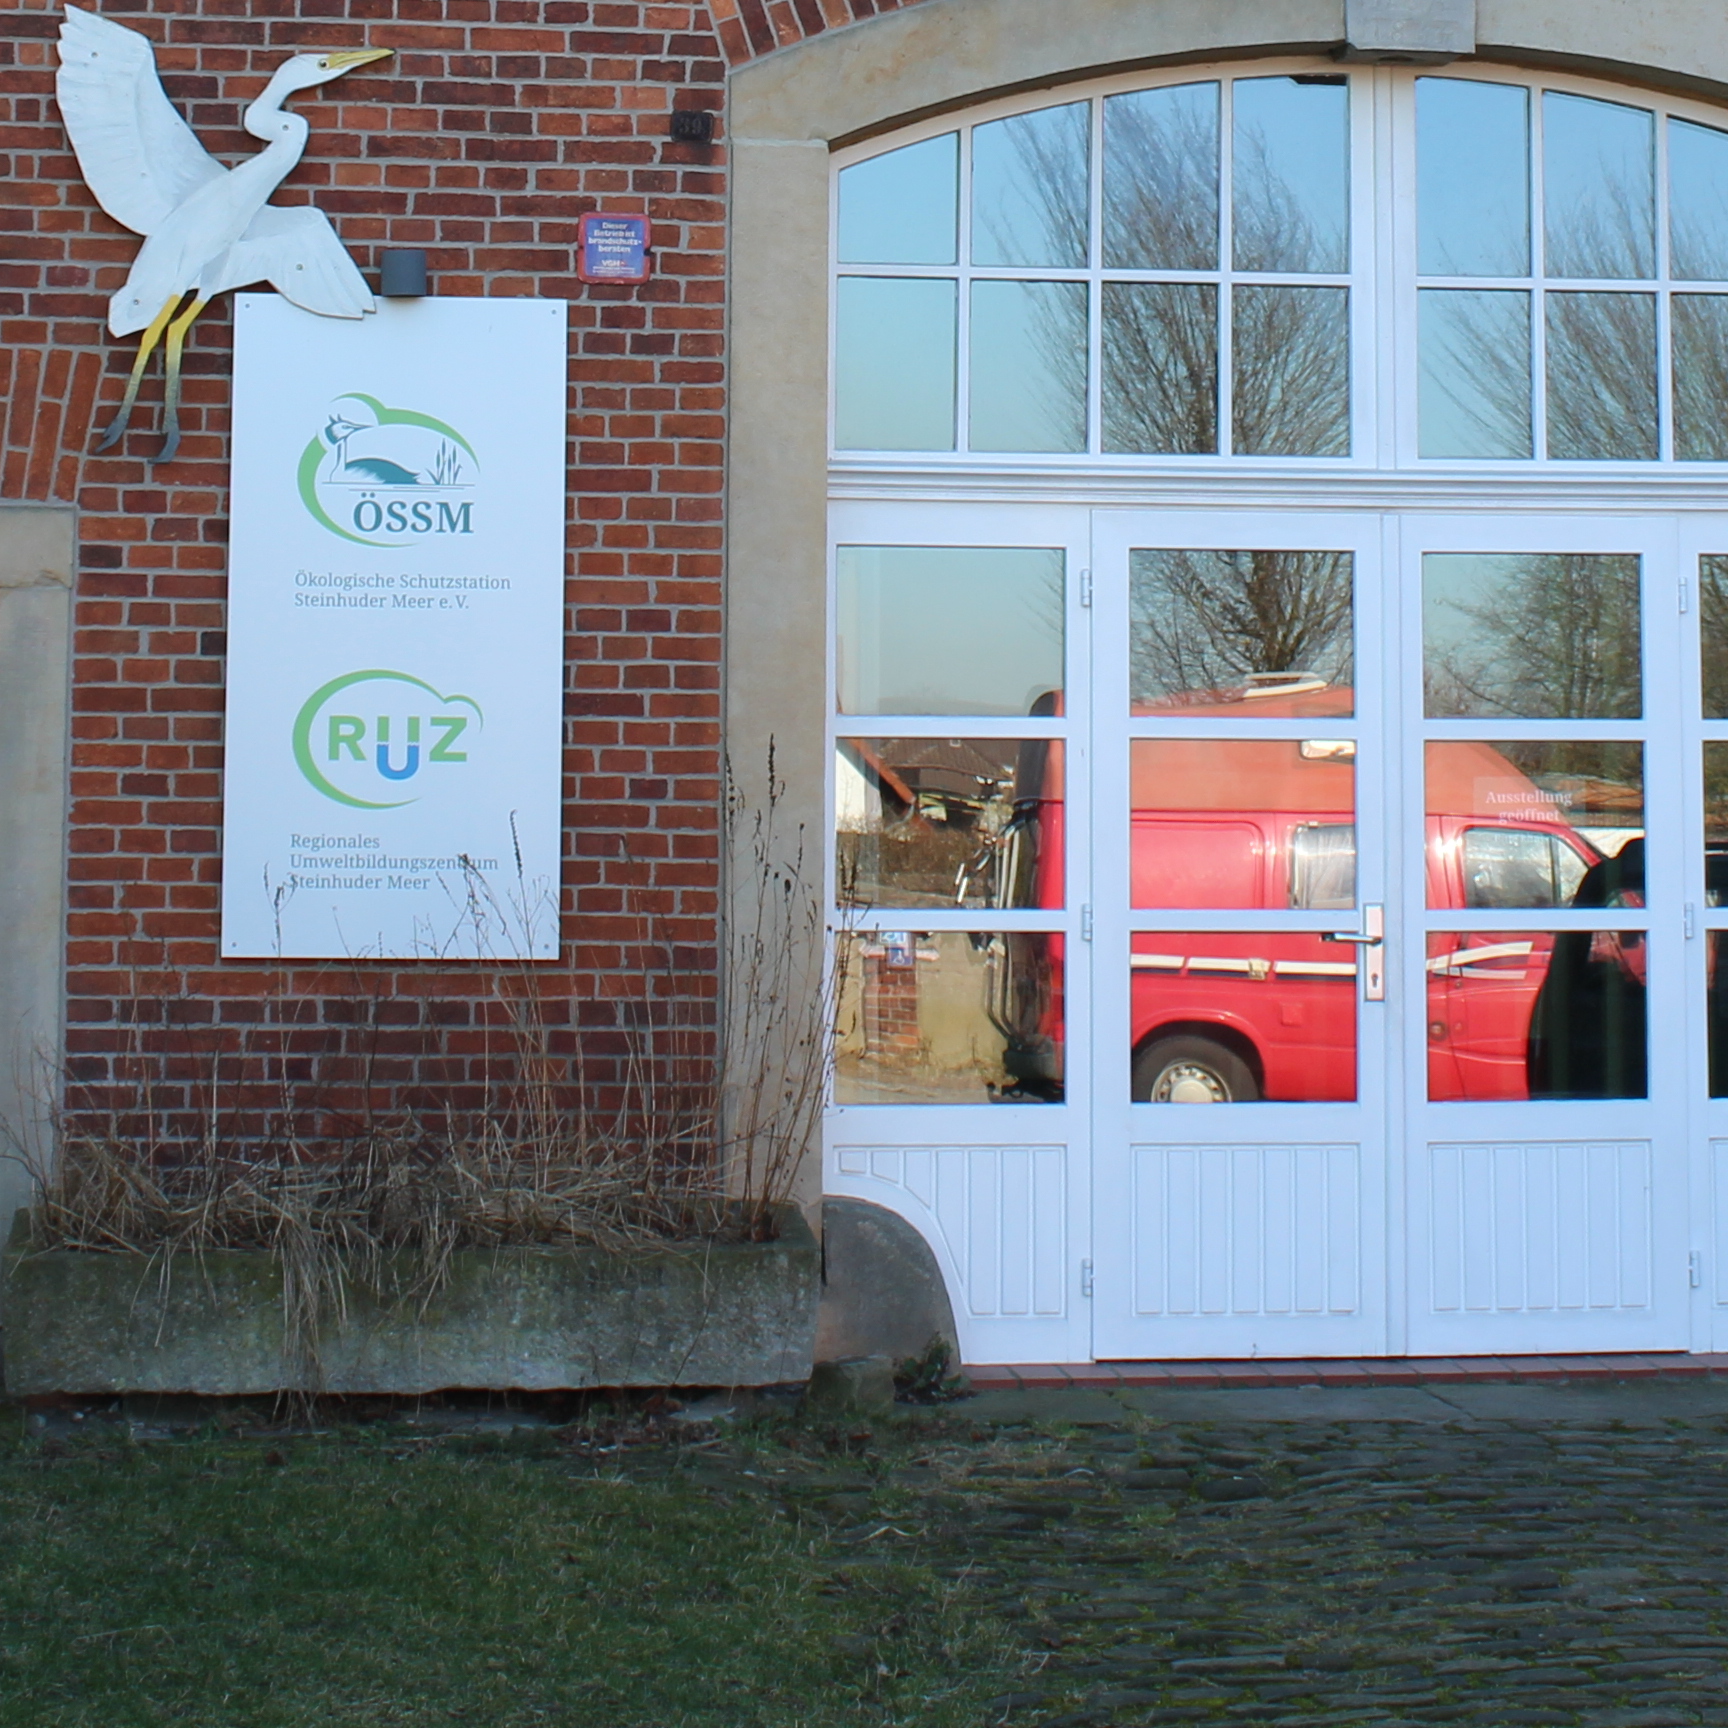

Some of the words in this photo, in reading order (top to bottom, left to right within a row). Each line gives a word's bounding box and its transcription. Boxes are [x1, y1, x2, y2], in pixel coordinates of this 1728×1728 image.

[353, 491, 475, 534] ÖSSM
[295, 569, 395, 591] Ökologische
[399, 573, 511, 590] Schutzstation
[294, 592, 386, 608] Steinhuder
[391, 594, 434, 609] Meer
[328, 715, 468, 781] RUZ
[1486, 790, 1572, 806] Ausstellung
[1498, 808, 1559, 824] geöffnet
[290, 833, 381, 852] Regionales
[289, 874, 382, 890] Steinhuder
[387, 875, 430, 890] Meer
